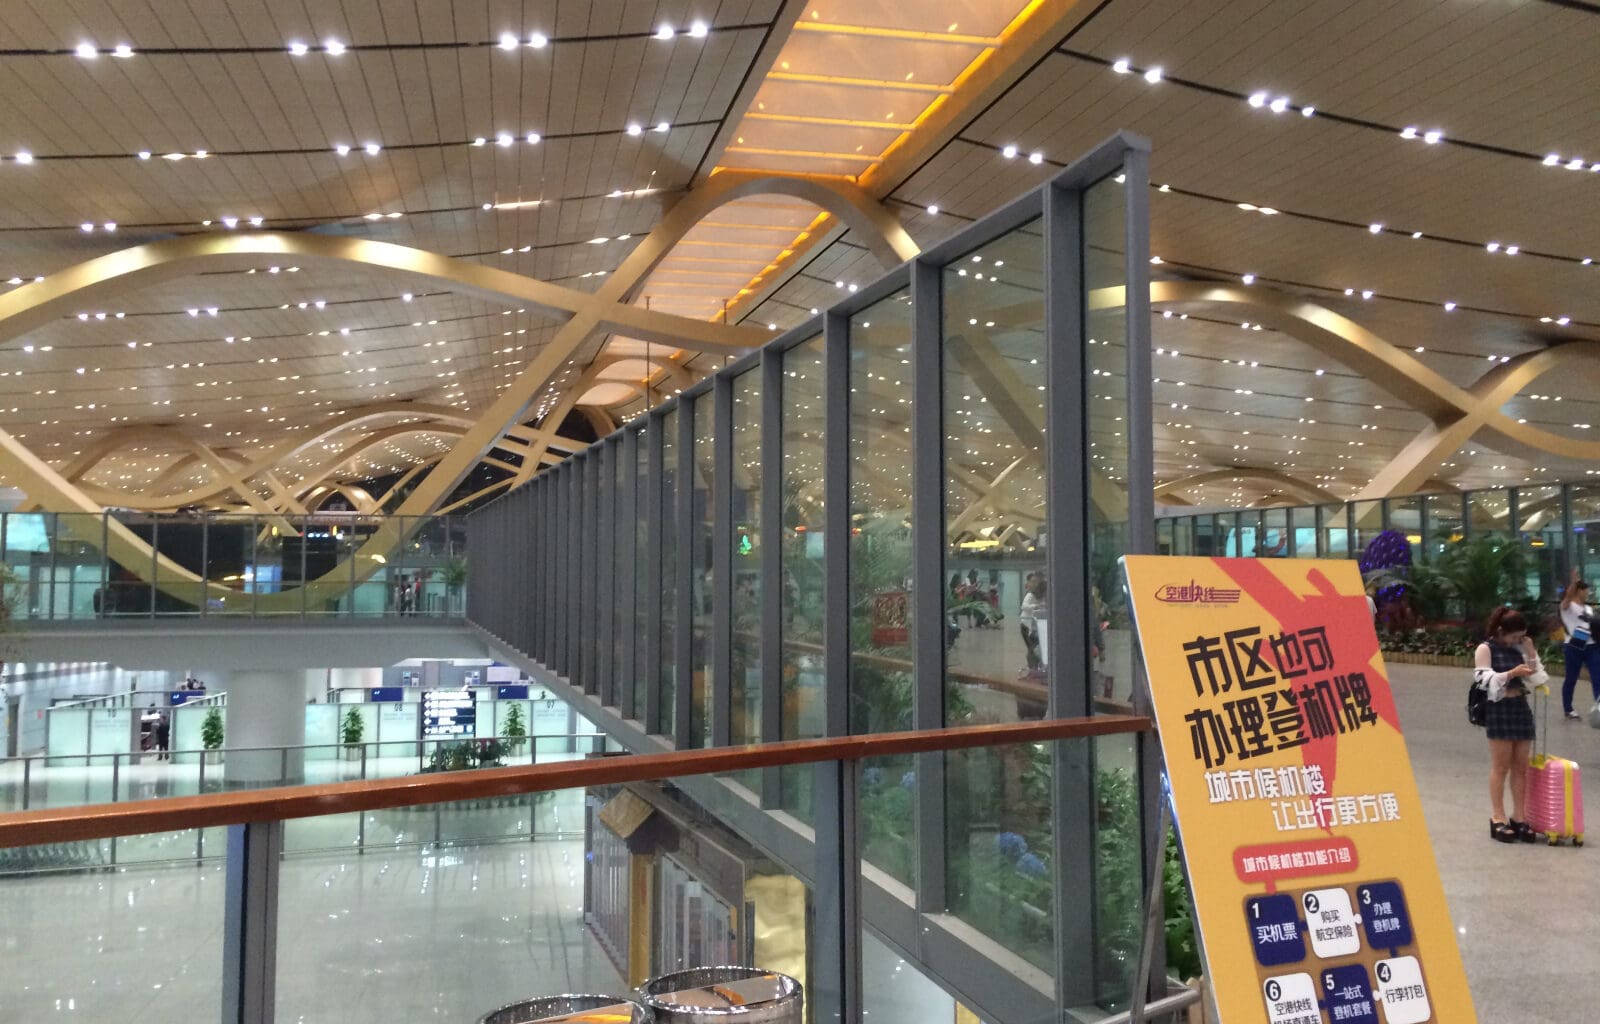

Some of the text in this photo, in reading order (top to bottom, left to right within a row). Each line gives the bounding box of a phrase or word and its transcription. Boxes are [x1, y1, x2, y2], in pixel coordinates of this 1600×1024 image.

[1183, 626, 1335, 697] 市区也可
[1184, 672, 1378, 769] 办理登机牌
[1204, 765, 1327, 803] 城市候机楼
[1270, 793, 1401, 831] 让出行更方便
[1243, 847, 1351, 873] 城市候机楼功能介绍
[1307, 896, 1317, 911] 2
[1362, 889, 1372, 904] 3
[1252, 902, 1260, 918] 1
[1321, 909, 1340, 924] 购买
[1373, 902, 1393, 916] 办理
[1256, 922, 1298, 944] 买机票
[1315, 925, 1353, 942] 航空保险
[1373, 918, 1401, 933] 登机牌
[1380, 966, 1390, 980] 4
[1325, 974, 1335, 990] 5
[1269, 983, 1279, 999] 6
[1334, 985, 1364, 999] 一站式
[1385, 985, 1425, 1004] 行李打包
[1274, 998, 1313, 1016] 空港快线
[1334, 1002, 1372, 1021] 登机套餐
